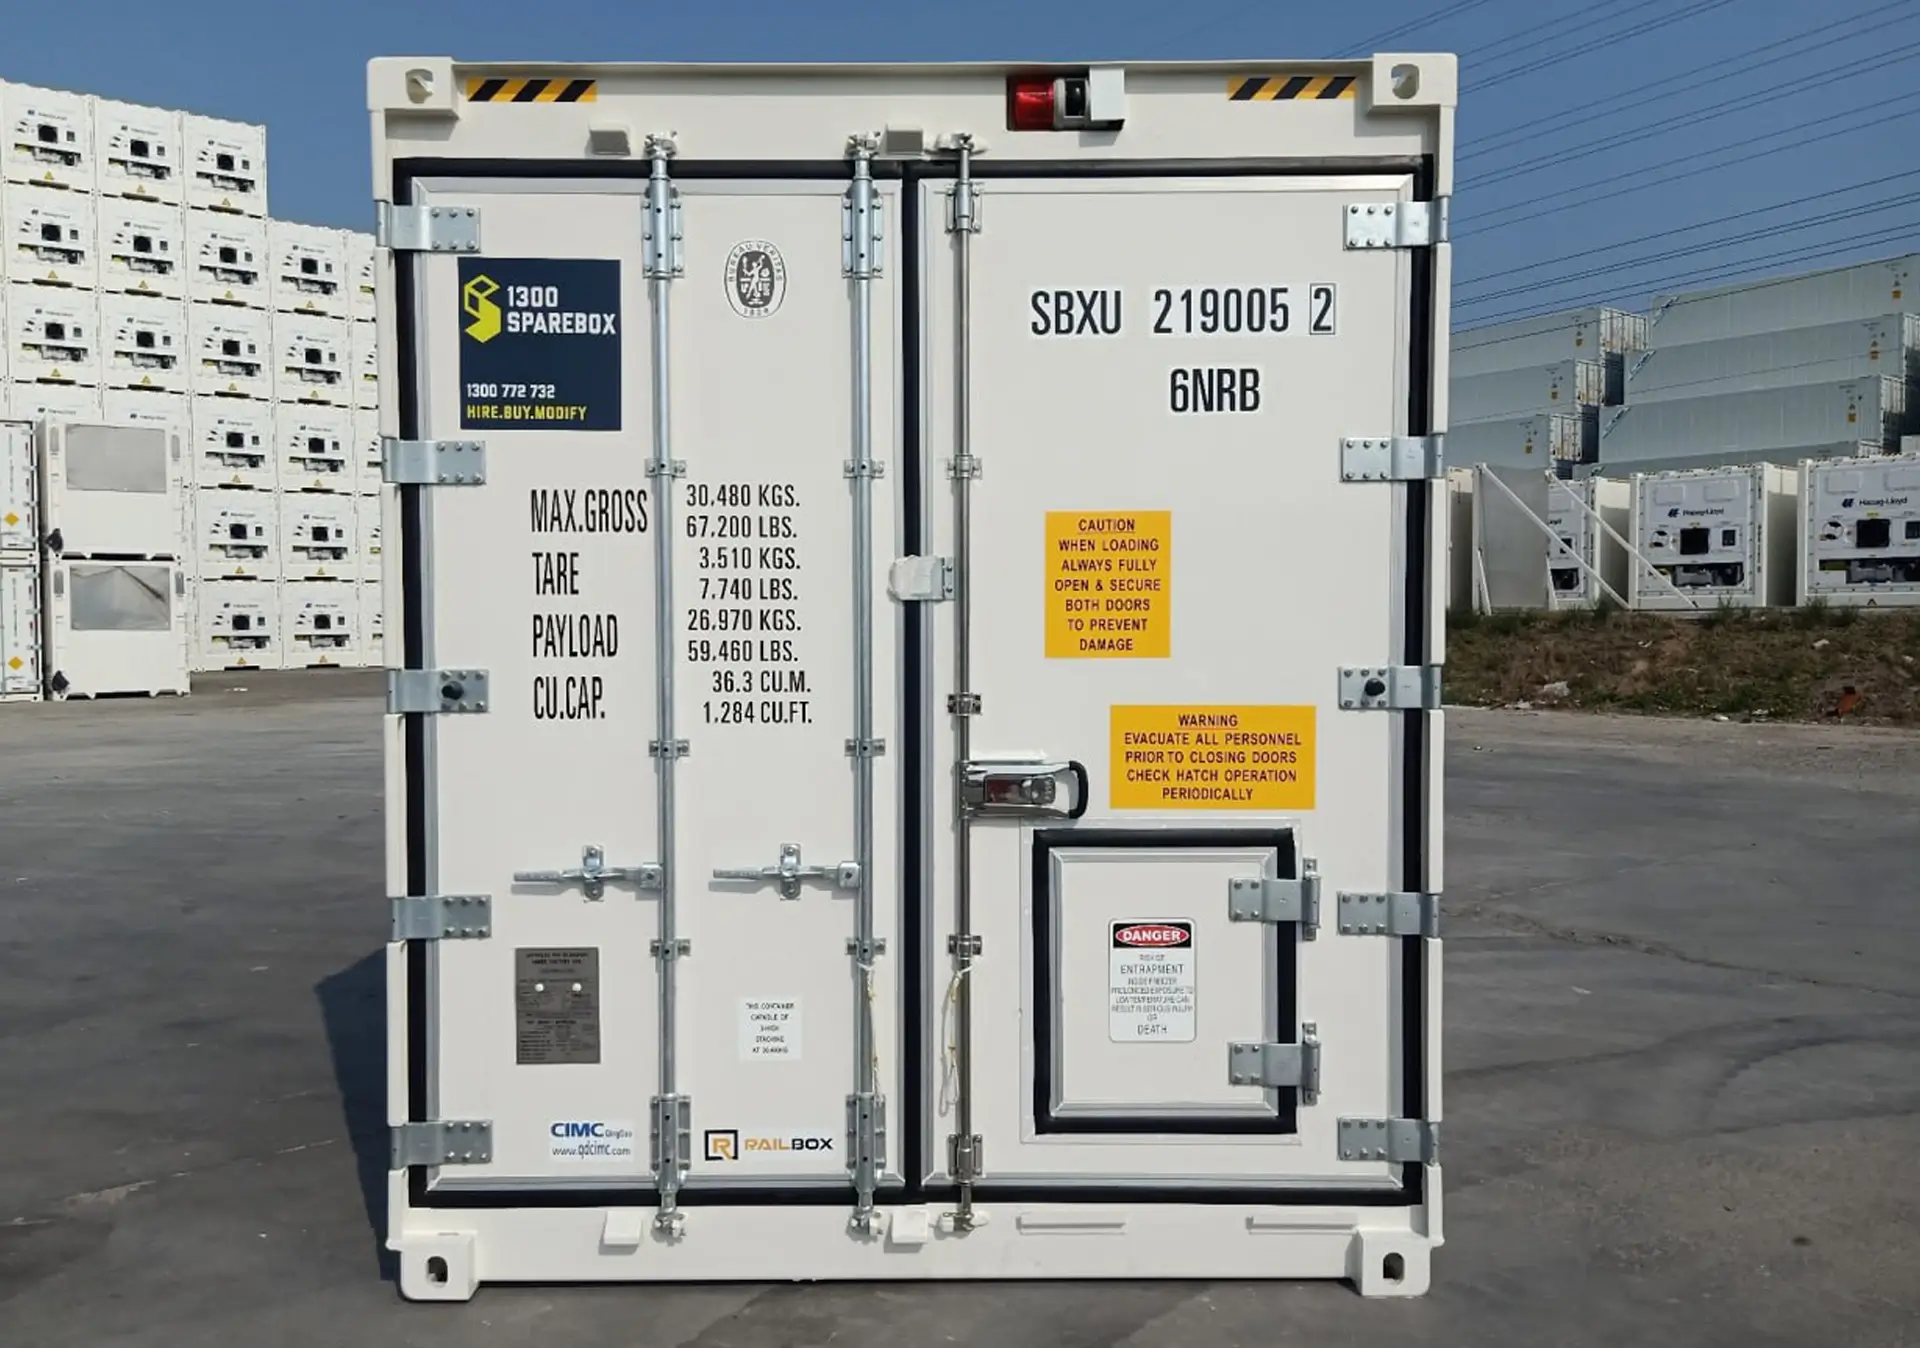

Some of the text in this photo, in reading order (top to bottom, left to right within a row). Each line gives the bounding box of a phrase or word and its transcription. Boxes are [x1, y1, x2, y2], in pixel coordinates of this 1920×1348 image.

[507, 286, 558, 307] 1300
[1031, 287, 1332, 335] SBXU 219005 2
[507, 312, 616, 335] SPAREBOX
[467, 384, 555, 399] 1300 772 732
[1170, 368, 1260, 412] 6NRB
[467, 405, 587, 421] HIRE.BUY.MODIFY
[758, 484, 800, 507] KGS.
[531, 489, 648, 533] MAX.GROSS
[759, 516, 797, 538] LBS.
[1078, 519, 1135, 531] CAUTION
[1059, 539, 1159, 551] WHEN LOADING
[759, 547, 800, 569] KGS.
[1061, 559, 1156, 571] ALWAYS FULLY
[532, 552, 579, 595] TARE
[760, 578, 798, 600] LBS.
[1055, 579, 1161, 591] OPEN & SECURE
[1065, 599, 1150, 611] BOTH DOORS
[760, 609, 801, 631] KGS.
[1068, 618, 1148, 631] TO PREVENT
[533, 614, 618, 657] PAYLOAD
[760, 640, 798, 662] LBS.
[1079, 639, 1133, 651] DAMAGE
[712, 671, 811, 692] 36.3 CU.M.
[534, 676, 605, 719] CU.CAP.
[761, 701, 812, 723] CU.FT.
[1178, 715, 1238, 727] WARNING
[1124, 733, 1301, 745] EVACUATE ALL PERSONNEL
[1125, 751, 1297, 763] PRIOR TO CLOSING DOORS
[1127, 769, 1297, 782] CHECK HATCH OPERATION
[1162, 788, 1253, 800] PERIODICALLY
[1123, 930, 1181, 941] DANGER
[1120, 964, 1184, 974] ENTRAPMENT
[1137, 1024, 1167, 1035] DEATH
[551, 1123, 604, 1137] CIMC
[552, 1140, 631, 1159] www.qdcimc.com
[745, 1138, 833, 1151] RAILBOX
